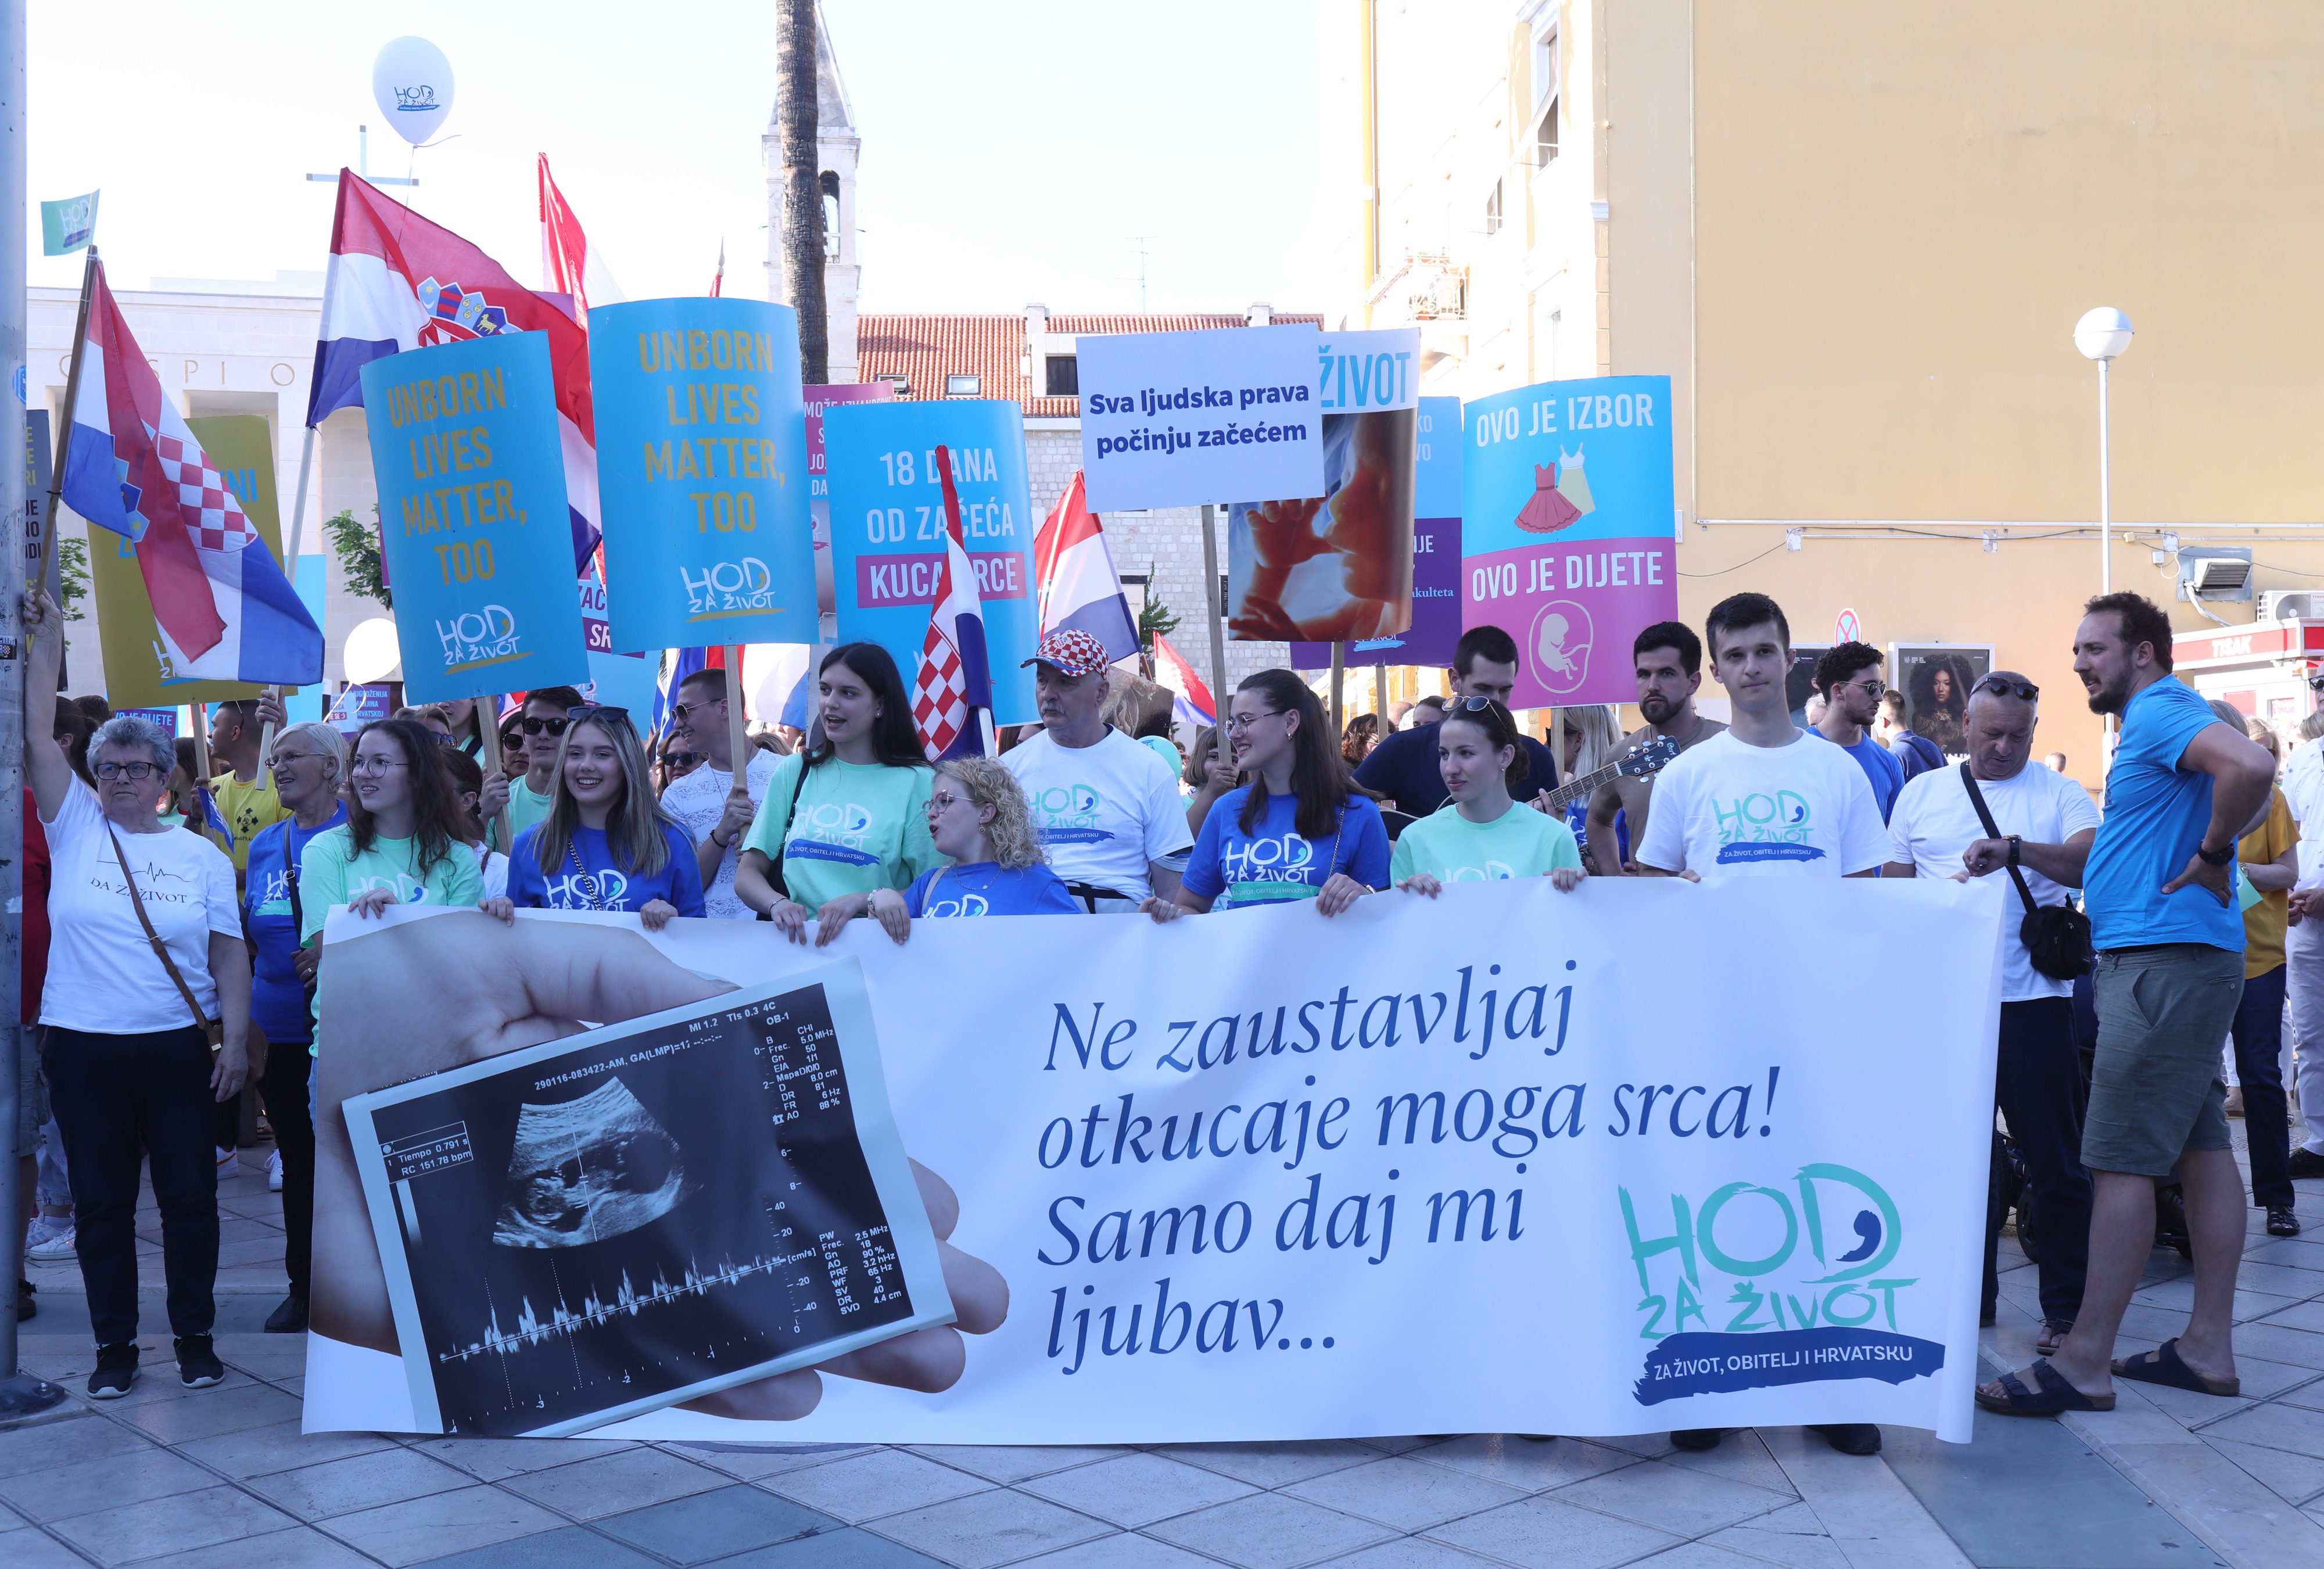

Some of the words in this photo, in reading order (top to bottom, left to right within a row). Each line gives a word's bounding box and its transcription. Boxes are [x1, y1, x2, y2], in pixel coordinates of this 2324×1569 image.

[394, 85, 433, 100] HOD
[638, 329, 773, 373] UNBORN
[1318, 344, 1411, 409] ŽIVOT
[387, 367, 507, 428] UNBORN
[666, 384, 760, 425] LIVES
[1089, 393, 1134, 414] Sva
[1141, 385, 1233, 417] ljudska
[1239, 382, 1309, 410] prava
[1476, 406, 1520, 447] OVO
[1528, 399, 1557, 436] JE
[1568, 393, 1654, 432] IZBOR
[409, 426, 493, 479] LIVES
[1097, 425, 1192, 459] počinju
[1197, 421, 1307, 447] začećem
[644, 437, 785, 488] MATTER,
[879, 450, 916, 486] 18
[926, 448, 998, 485] DANA
[401, 479, 527, 537] MATTER,
[690, 491, 756, 533] TOO
[866, 507, 906, 543] OD
[915, 496, 1014, 541] ZAČEĆA
[434, 538, 496, 585] TOO
[974, 557, 1018, 592] RCE
[680, 557, 771, 600] HOD
[1472, 563, 1517, 602] OVO
[1526, 557, 1555, 594] JE
[1566, 551, 1663, 589] DIJETE
[688, 593, 718, 613] ZA
[723, 591, 776, 610] ŽIVOT
[435, 604, 515, 651] HOD
[444, 648, 465, 665] ZA
[469, 636, 521, 661] ŽIVOT
[2211, 635, 2252, 658] TISAK
[794, 803, 872, 834] HOD
[1046, 814, 1103, 828] ŽIVOT
[1712, 790, 1810, 832] HOD
[789, 823, 807, 841] ZA
[810, 827, 872, 851] ŽIVOT
[1718, 824, 1746, 844] ZA
[1752, 825, 1815, 845] ŽIVOT
[809, 848, 832, 856] OBITELJ
[835, 851, 865, 861] HRVATSKU
[1225, 833, 1313, 871] HOD
[543, 869, 627, 905] HOD
[1225, 864, 1250, 884] ZA
[1254, 865, 1317, 884] ŽIVOT
[90, 877, 110, 891] DA
[138, 888, 187, 903] ŽIVOT
[262, 888, 283, 904] ZA
[688, 1023, 701, 1033] MI
[703, 1018, 719, 1029] 1.2
[744, 1006, 758, 1018] 0.3
[763, 1002, 776, 1012] 4C
[766, 1012, 790, 1025] OB-1
[1042, 1002, 1138, 1071] Ne
[1156, 959, 1578, 1072] zaustavljaj
[766, 1036, 773, 1044] B
[797, 1023, 813, 1035] CHI
[769, 1043, 790, 1054] Frec.
[801, 1034, 813, 1044] 5.0
[815, 1029, 834, 1040] MHz
[772, 1055, 784, 1063] Gn
[805, 1044, 816, 1053] 50
[535, 1057, 628, 1091] 290116-083422-AM,
[779, 1083, 786, 1092] D
[810, 1072, 823, 1082] 8.0
[825, 1069, 838, 1078] cm
[781, 1091, 795, 1101] DR
[815, 1081, 824, 1091] 81
[784, 1101, 797, 1111] FR
[822, 1091, 828, 1099] 6
[829, 1087, 841, 1097] Hz
[787, 1110, 799, 1120] AO
[819, 1100, 830, 1110] 88
[831, 1097, 840, 1106] %
[1037, 1074, 1350, 1170] otkucaje
[1375, 1082, 1587, 1158] moga
[1608, 1066, 1781, 1140] srca!
[398, 1148, 432, 1163] Tiempo
[436, 1139, 459, 1153] 0.791
[401, 1165, 416, 1176] RC
[419, 1156, 449, 1170] 151.78
[451, 1151, 471, 1163] bpm
[774, 1201, 785, 1210] 40
[1037, 1195, 1252, 1266] Samo
[1275, 1169, 1401, 1266] daj
[1425, 1163, 1528, 1244] mi
[781, 1227, 792, 1237] 20
[819, 1231, 834, 1242] PW
[822, 1240, 844, 1252] Frec.
[855, 1231, 869, 1241] 2.5
[869, 1225, 888, 1236] MHz
[1618, 1163, 1902, 1299] HOD
[787, 1247, 816, 1264] [cm/s]
[824, 1251, 838, 1260] Gn
[860, 1240, 871, 1249] 18
[827, 1259, 841, 1270] AO
[863, 1249, 873, 1258] 90
[874, 1246, 884, 1254] %
[829, 1266, 848, 1278] PRF
[863, 1258, 877, 1269] 3.2
[831, 1277, 847, 1288] WF
[867, 1267, 879, 1277] 65
[880, 1262, 893, 1273] Hz
[835, 1286, 848, 1297] SV
[875, 1276, 881, 1284] 3
[837, 1295, 852, 1306] DR
[873, 1285, 884, 1295] 40
[840, 1302, 860, 1315] SVD
[874, 1294, 887, 1304] 4.4
[888, 1289, 902, 1300] cm
[1635, 1275, 1709, 1340] ZA
[1724, 1277, 1921, 1334] ŽIVOT
[1047, 1277, 1335, 1376] ljubav...
[1654, 1364, 1672, 1381] ZA
[1674, 1356, 1725, 1378] ŽIVOT,
[1727, 1351, 1800, 1371] OBITELJ
[1805, 1350, 1809, 1364] I
[1814, 1345, 1913, 1364] HRVATSKU
